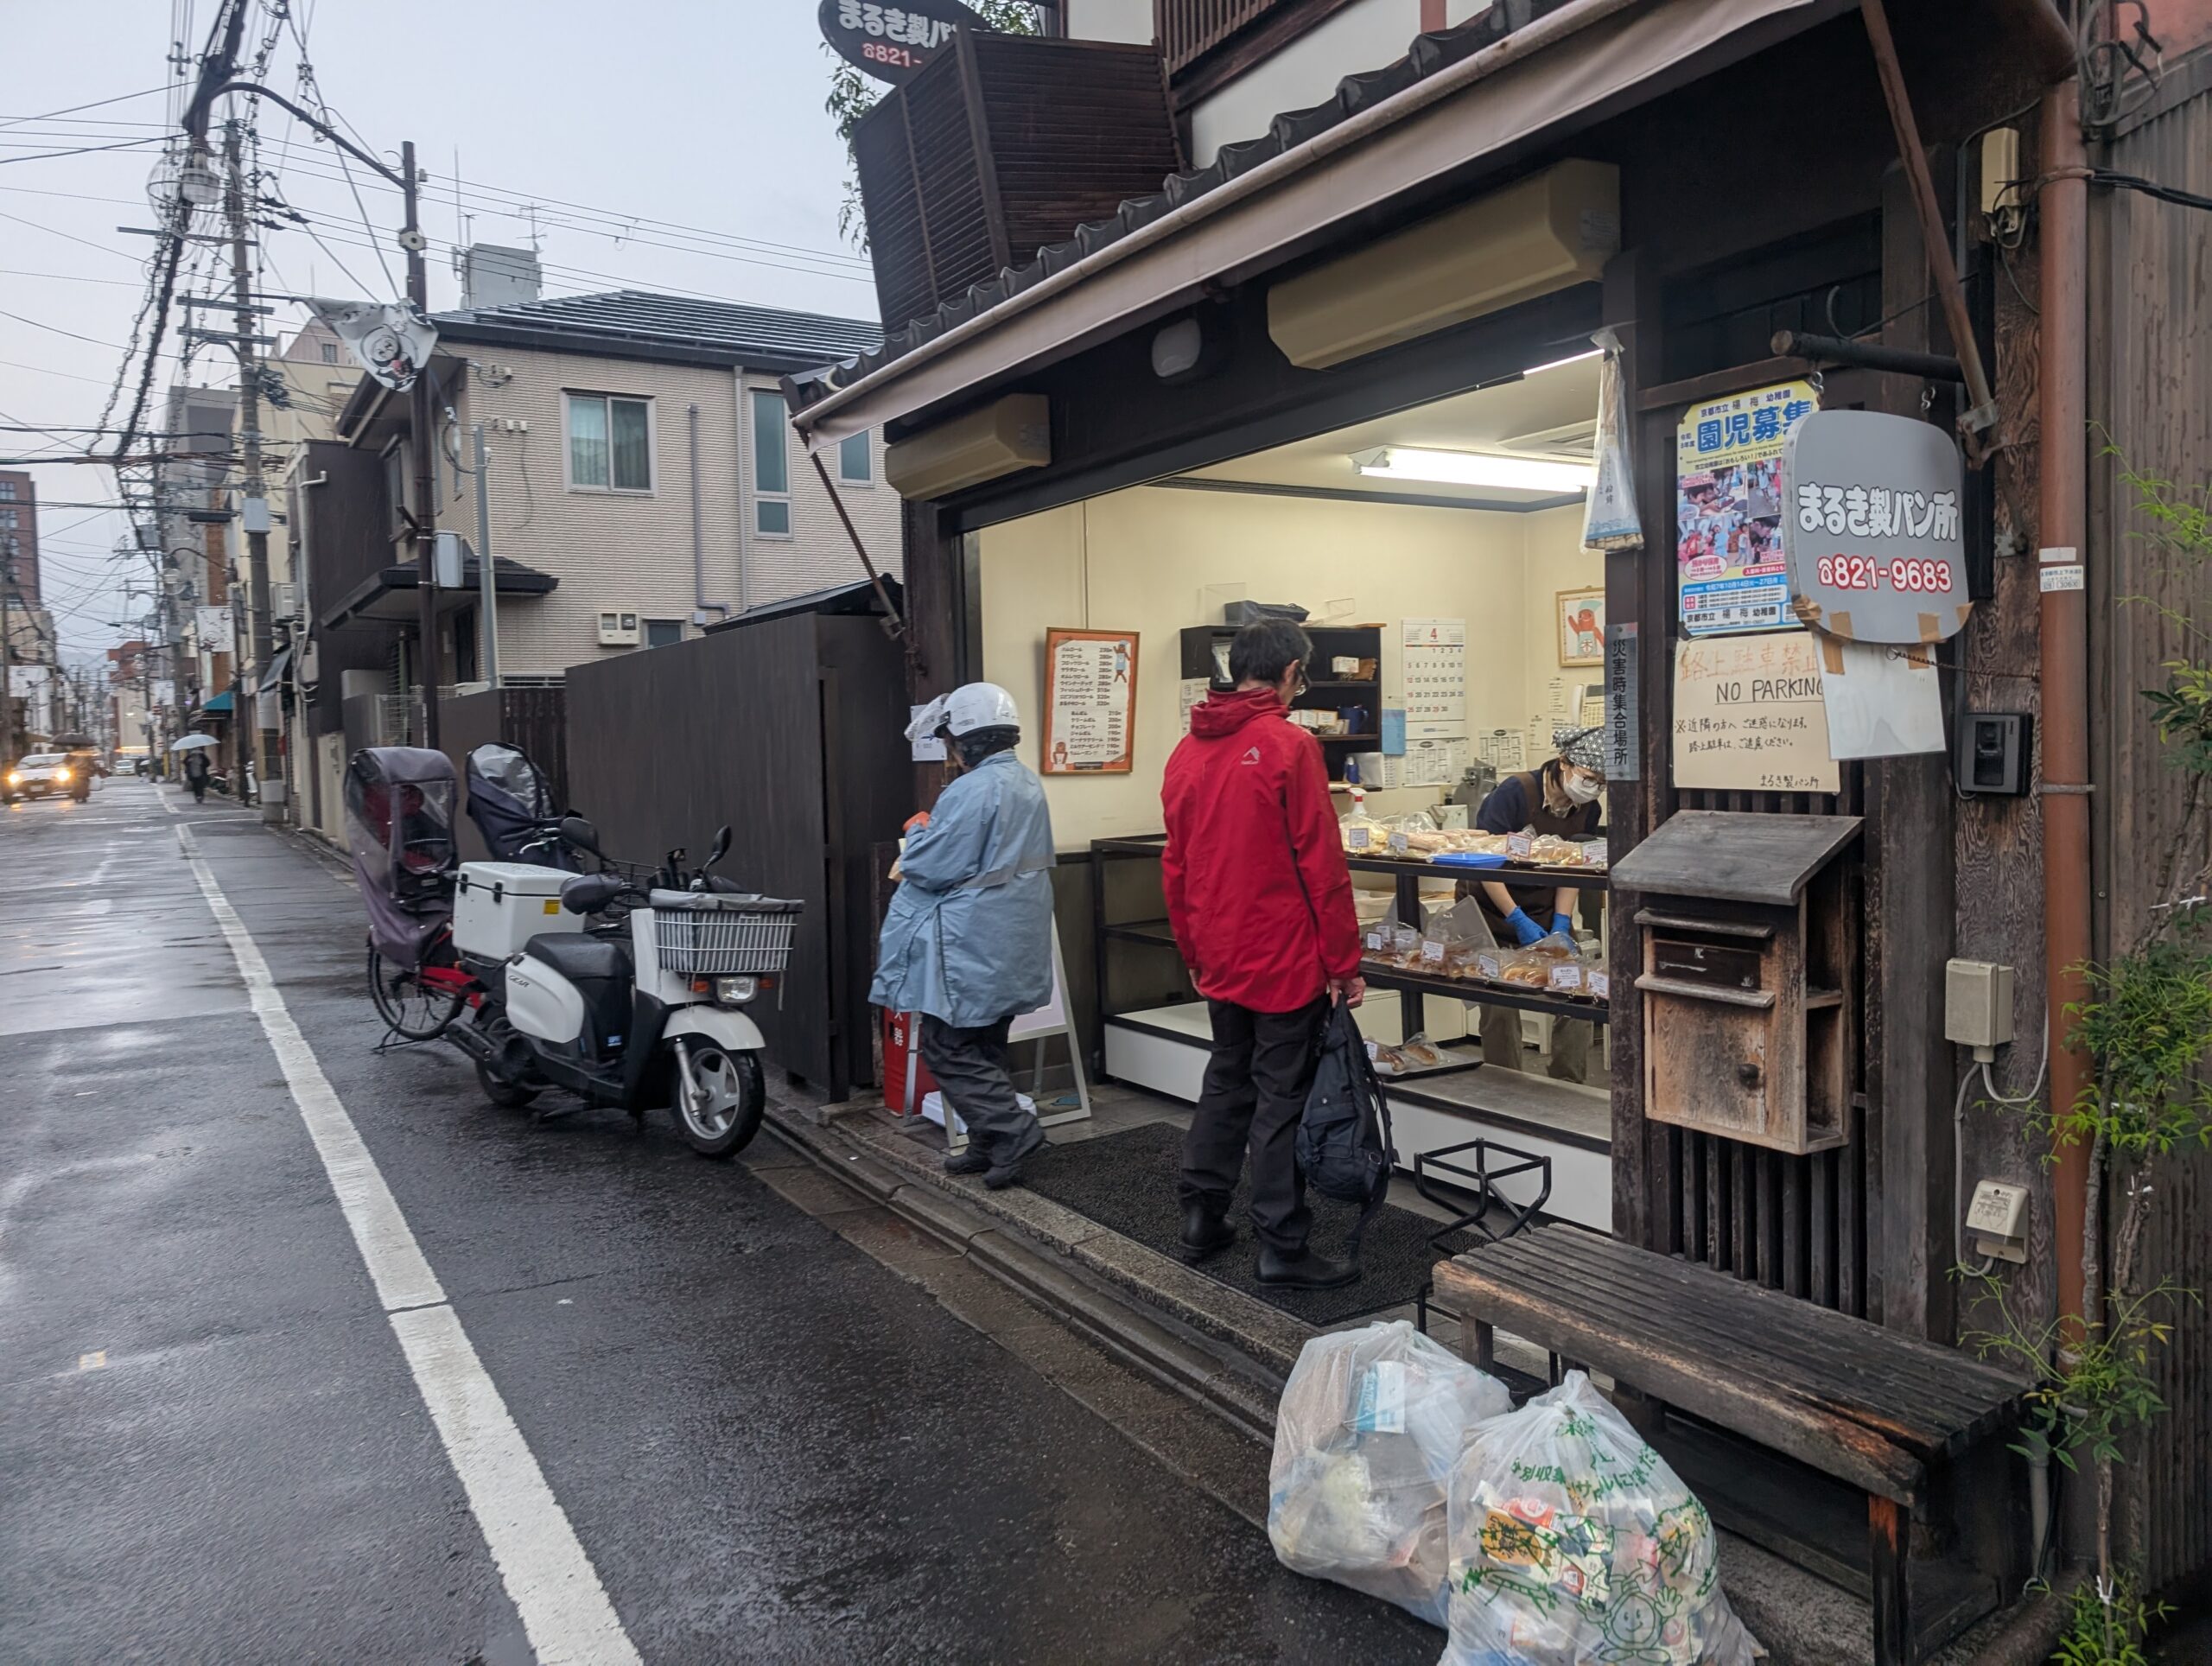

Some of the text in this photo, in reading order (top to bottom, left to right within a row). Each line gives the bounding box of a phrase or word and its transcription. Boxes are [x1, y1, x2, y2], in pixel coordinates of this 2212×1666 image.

[838, 0, 957, 48] まるき製パ
[1697, 400, 1812, 454] 園児募集
[1797, 481, 1958, 542] まるき製パン所
[1833, 553, 1952, 594] 821-9683
[1430, 628, 1438, 639] 4
[1611, 639, 1628, 766] 災害時集合場所
[1716, 682, 1741, 703] NO
